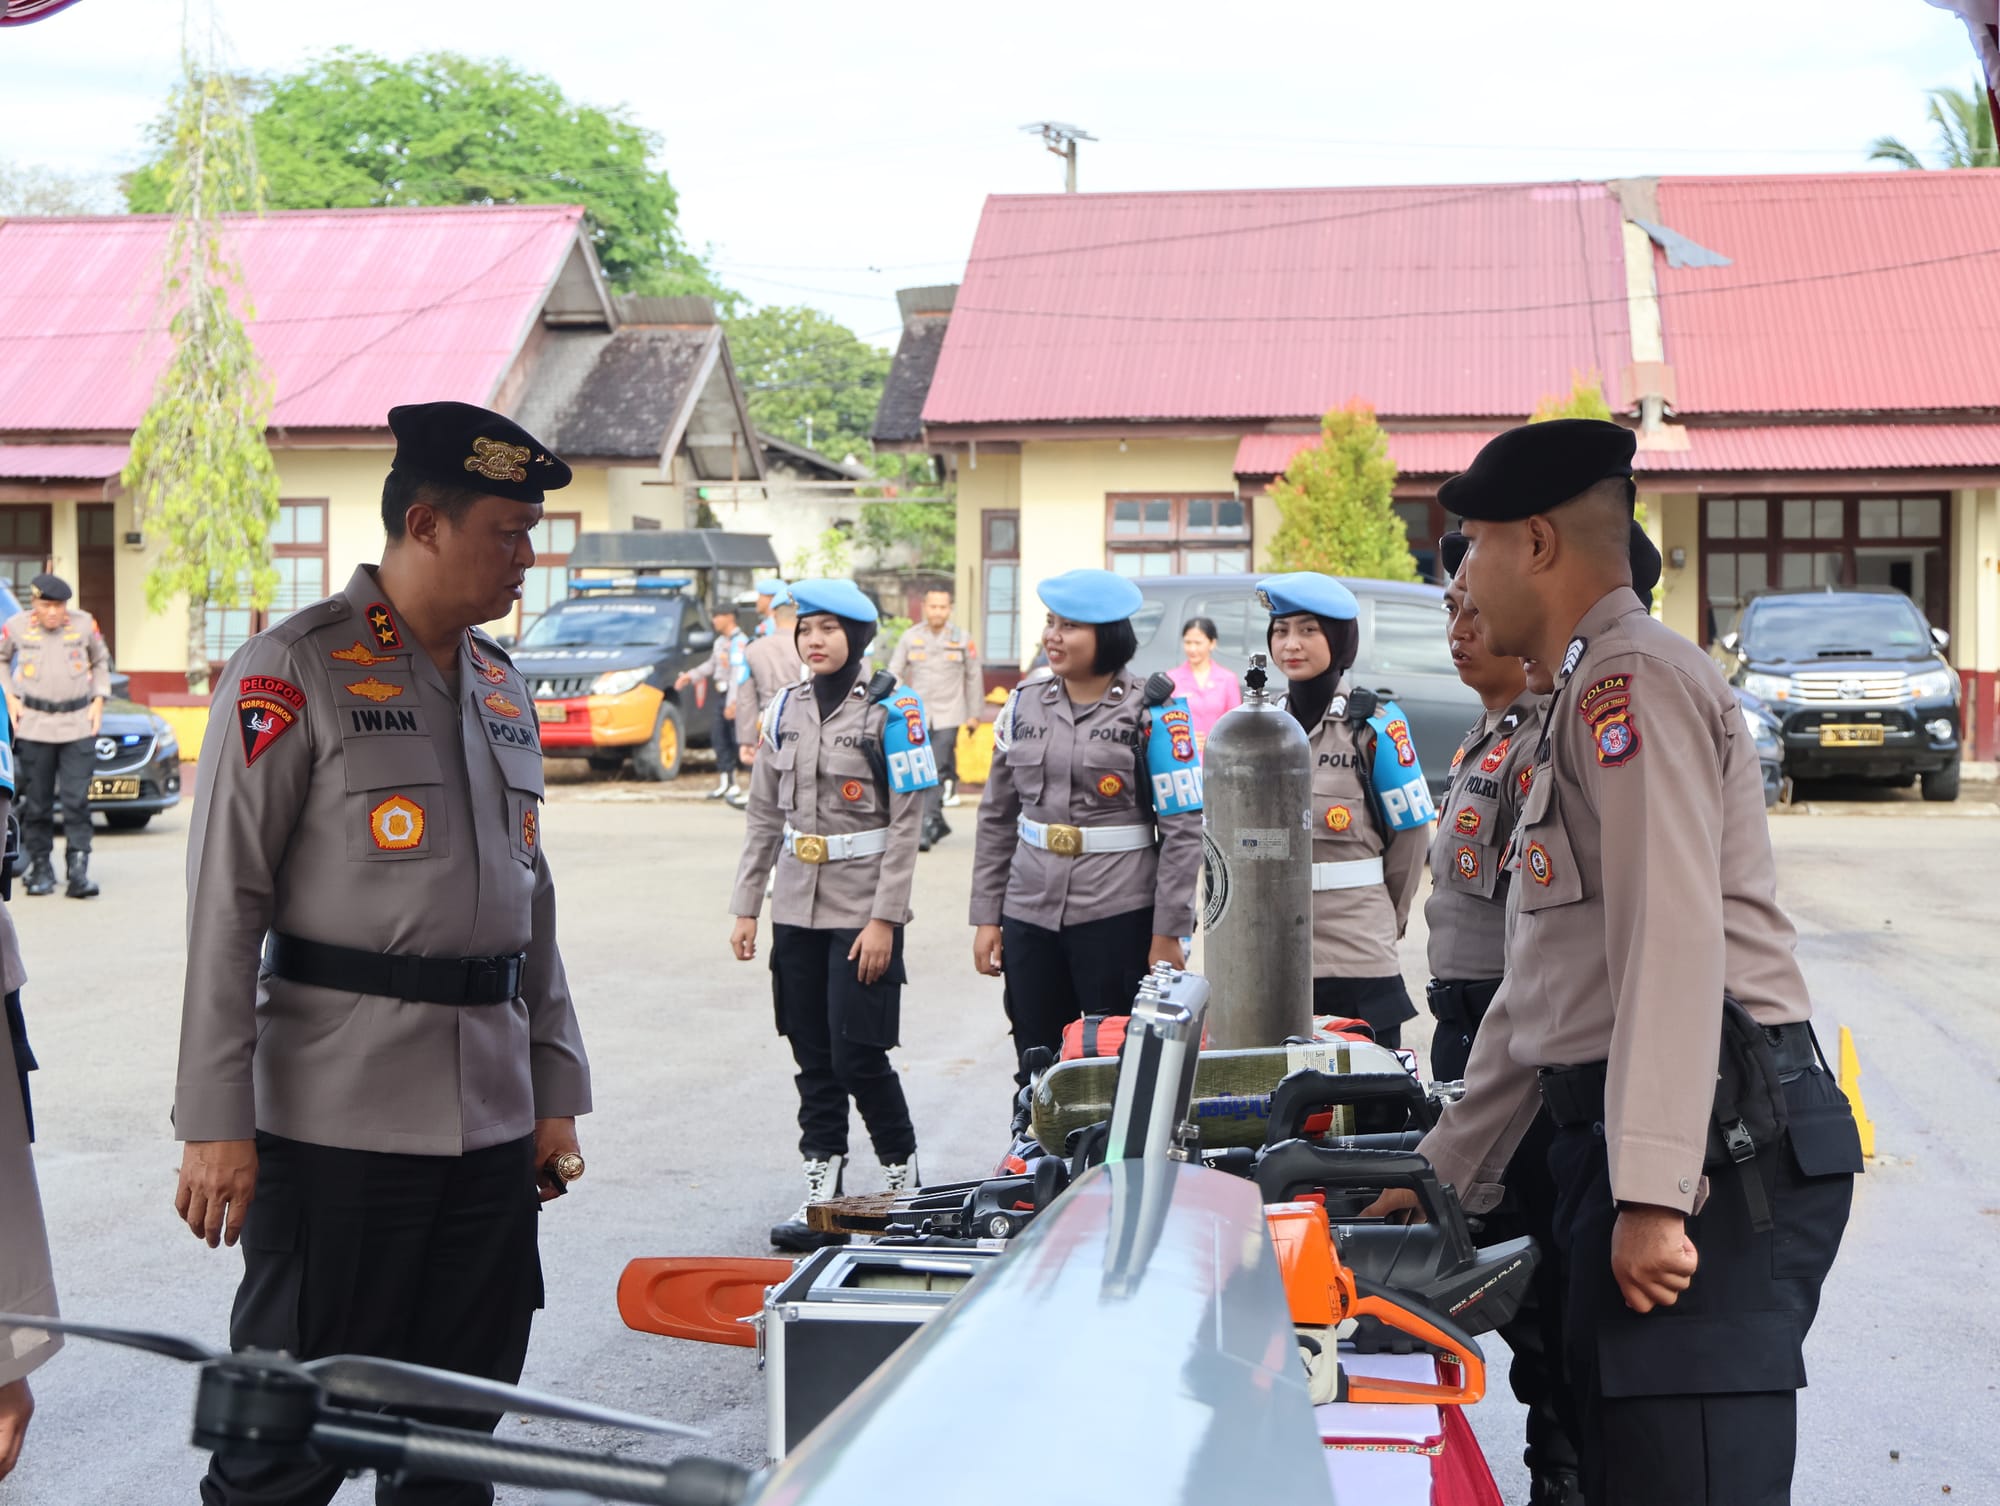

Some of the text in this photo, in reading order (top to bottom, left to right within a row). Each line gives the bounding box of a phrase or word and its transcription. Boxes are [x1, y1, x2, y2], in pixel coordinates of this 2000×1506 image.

[243, 679, 303, 706] PELOPOR
[1581, 678, 1624, 709] POLDA
[241, 700, 265, 710] KORPS
[353, 710, 417, 732] IWAN
[490, 721, 536, 746] POLRI
[1465, 776, 1499, 799] POLRI
[1498, 1259, 1522, 1279] PLUS
